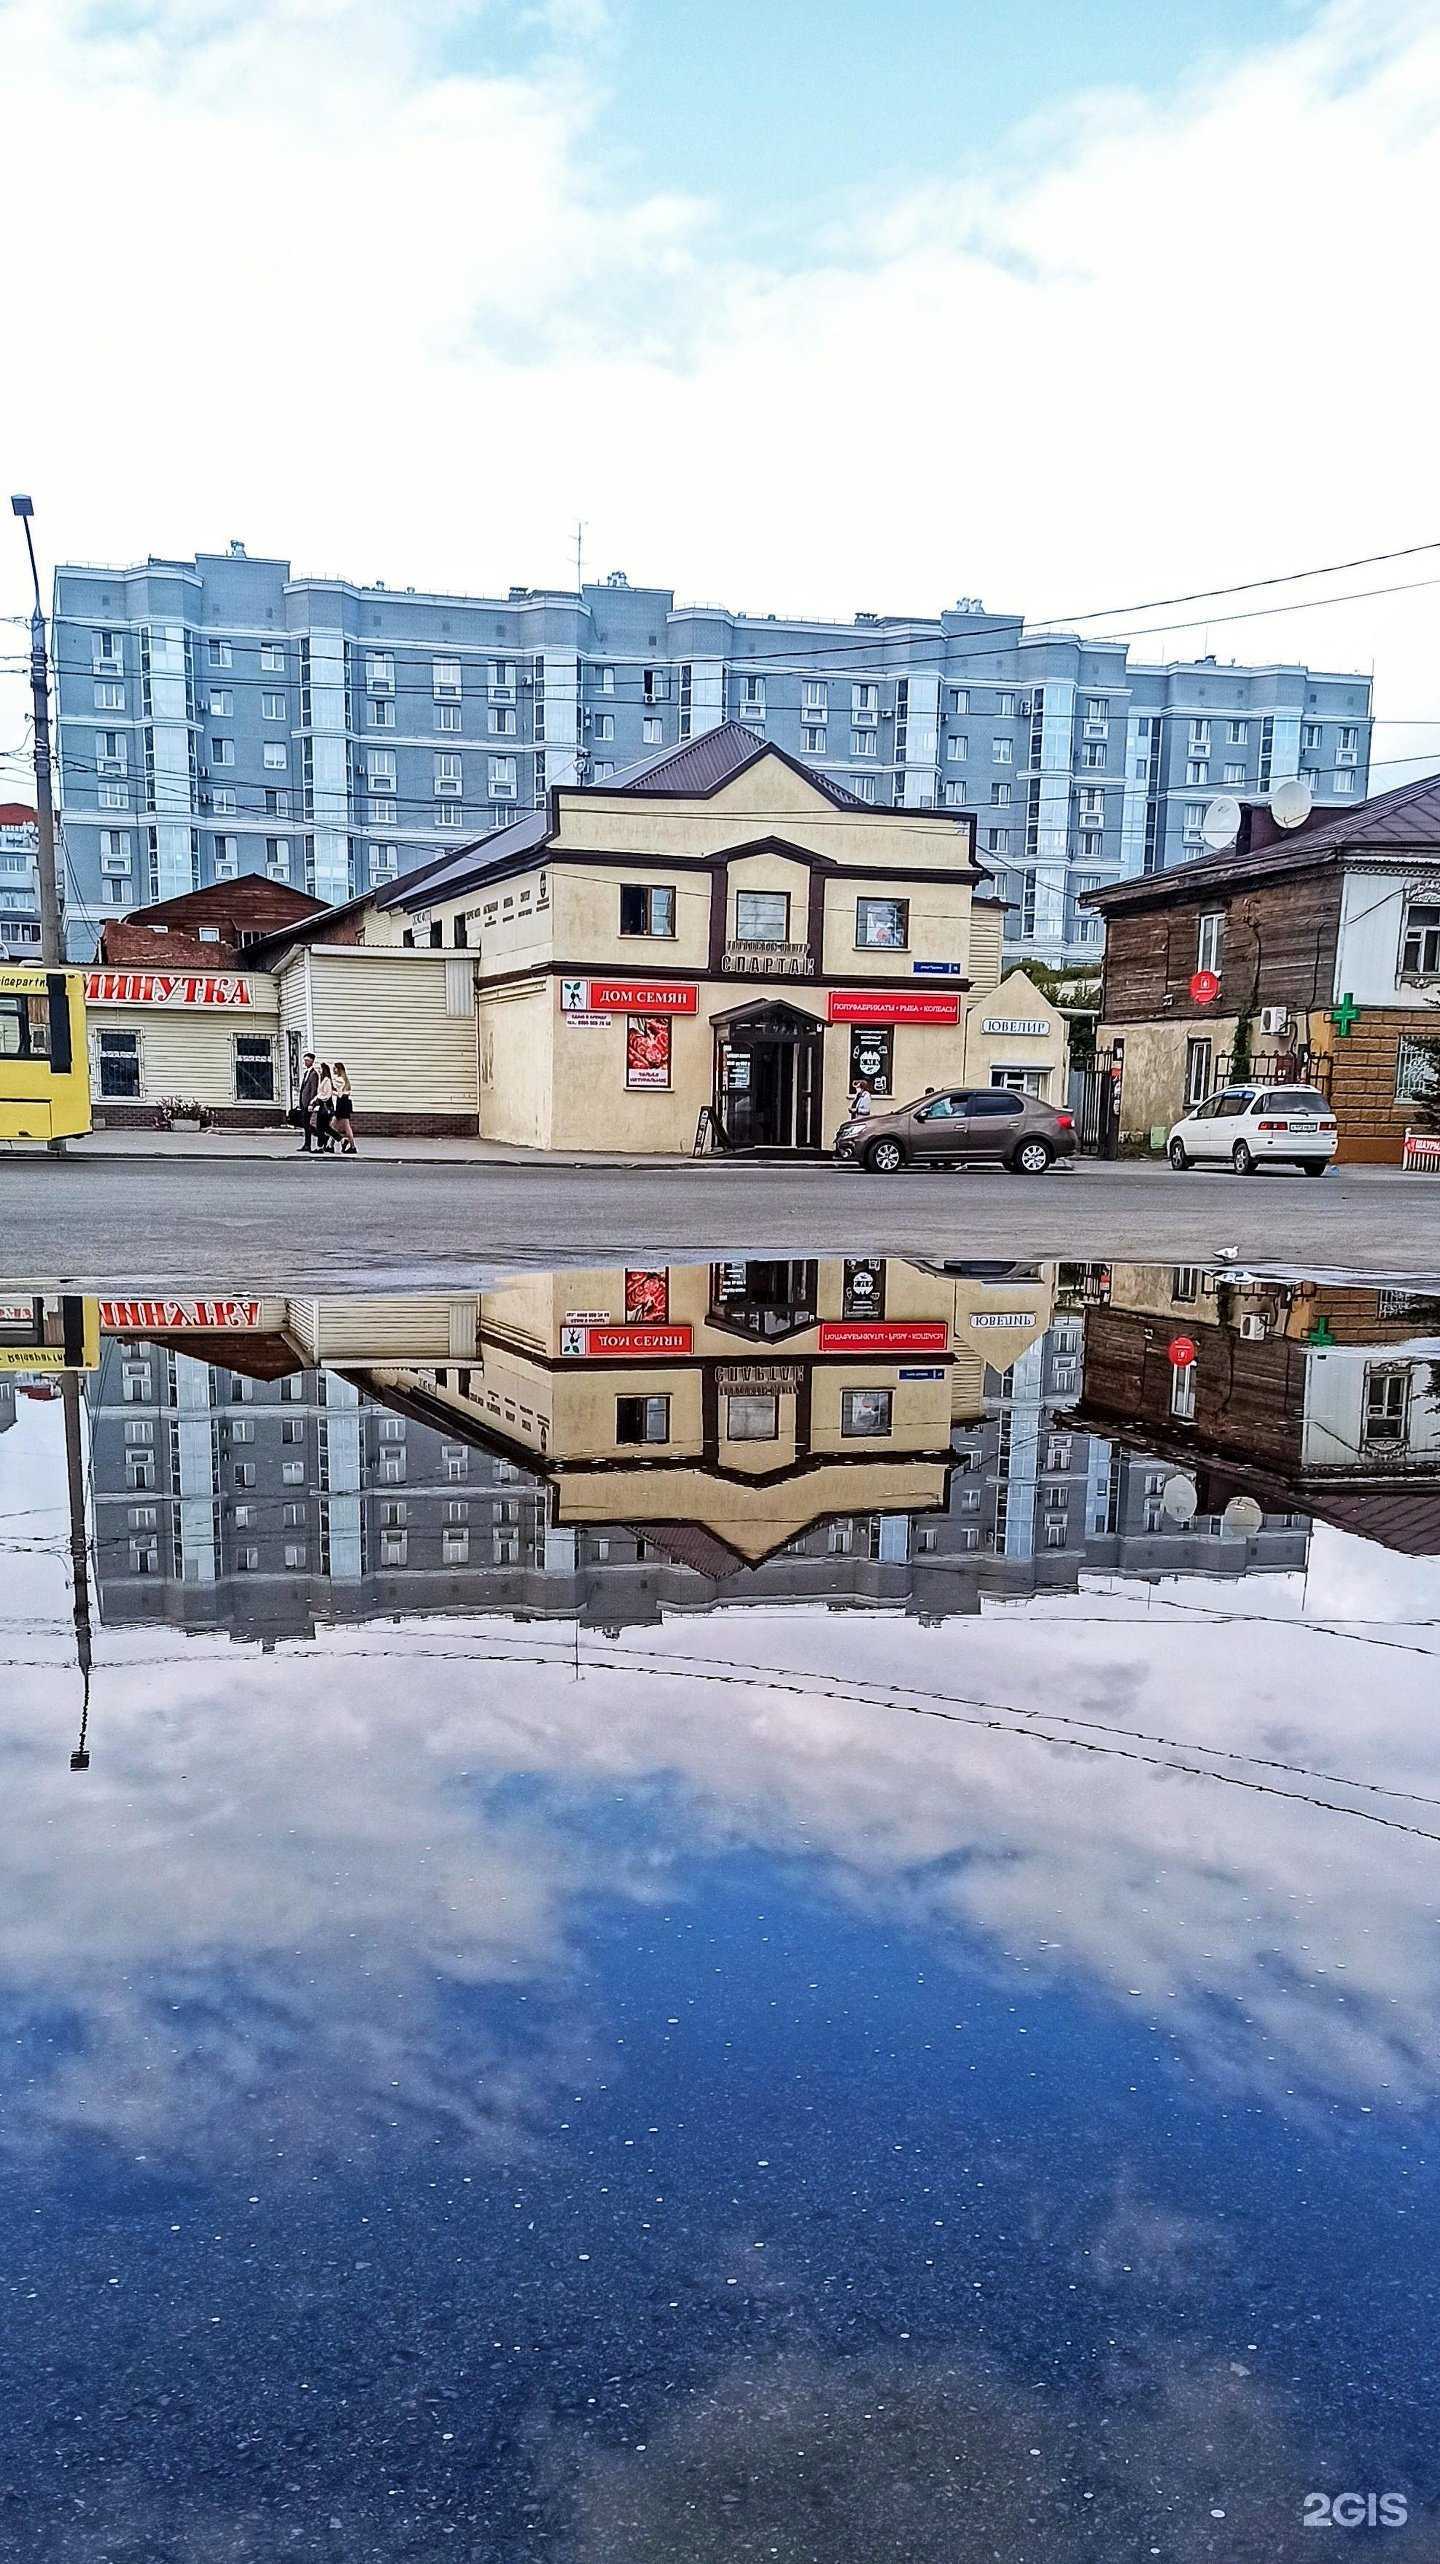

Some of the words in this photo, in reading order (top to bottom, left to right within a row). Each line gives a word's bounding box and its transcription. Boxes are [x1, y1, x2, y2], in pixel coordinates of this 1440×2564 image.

[722, 955, 815, 975] СПАРТАК
[0, 976, 49, 988] isepartn
[600, 990, 633, 1003] ДОМ
[636, 991, 687, 1004] СЕМЯН
[988, 1020, 1045, 1033] ЮВЕЛИР
